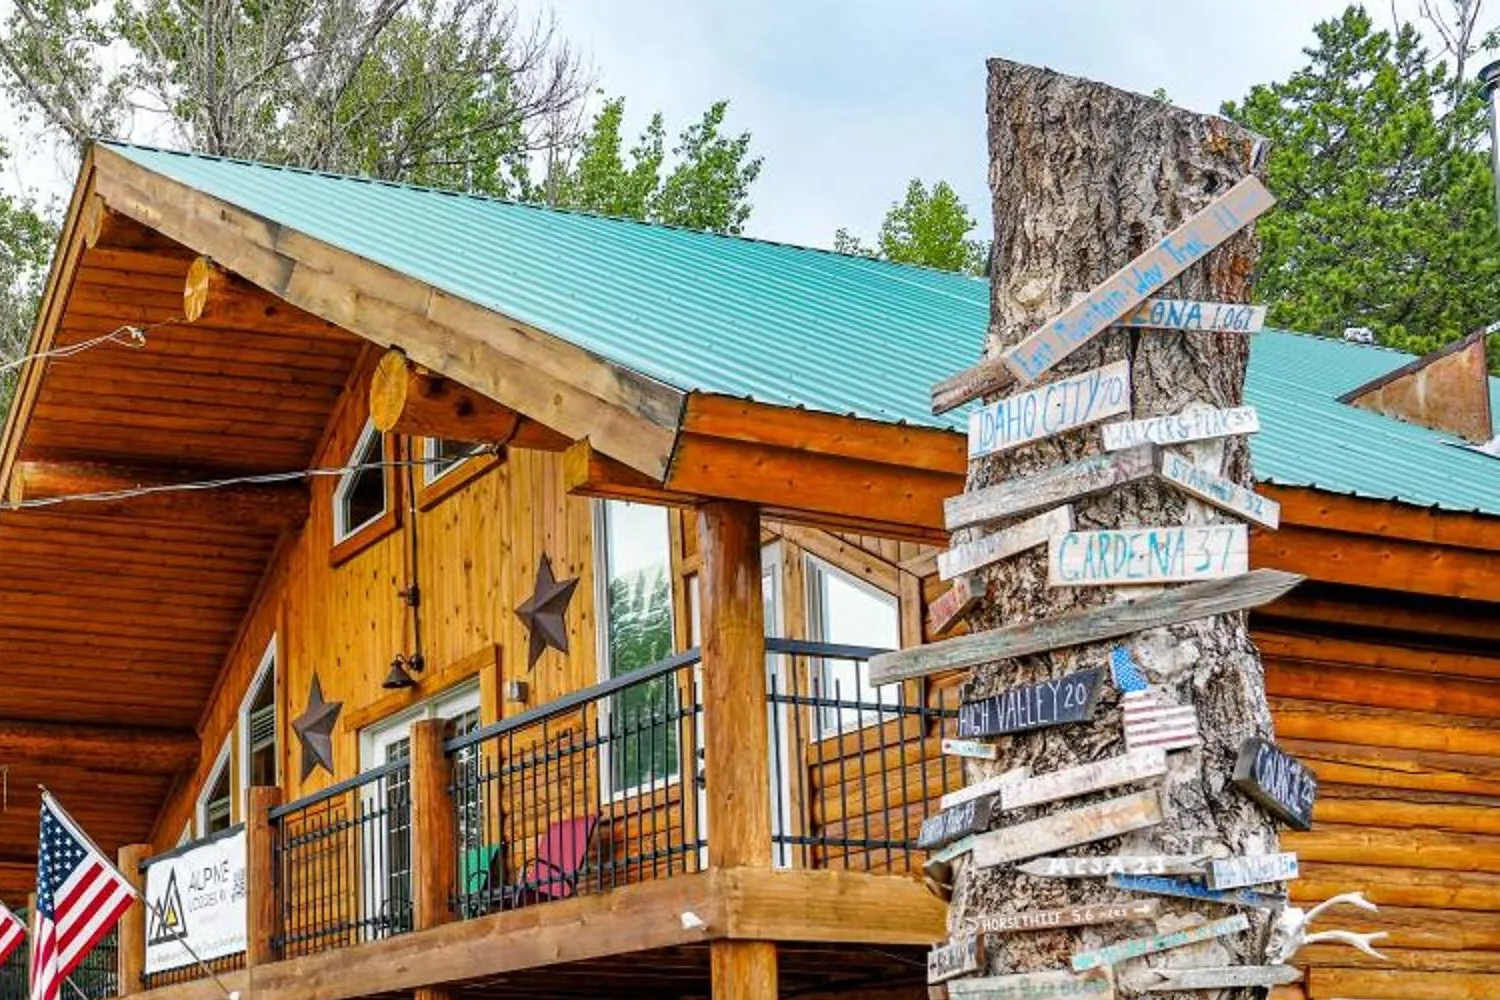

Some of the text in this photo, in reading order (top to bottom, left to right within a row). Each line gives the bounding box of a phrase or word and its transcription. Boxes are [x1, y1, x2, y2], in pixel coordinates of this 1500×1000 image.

[975, 393, 1037, 454] IDAHO
[1042, 371, 1101, 433] CITY
[1194, 527, 1236, 573] 37
[995, 681, 1062, 731] VALLEY
[1062, 682, 1088, 710] 20
[187, 858, 230, 893] ALPINE
[1048, 857, 1126, 876] MESA
[981, 911, 1063, 933] HORSETHIEF
[1071, 908, 1096, 923] 5.6
